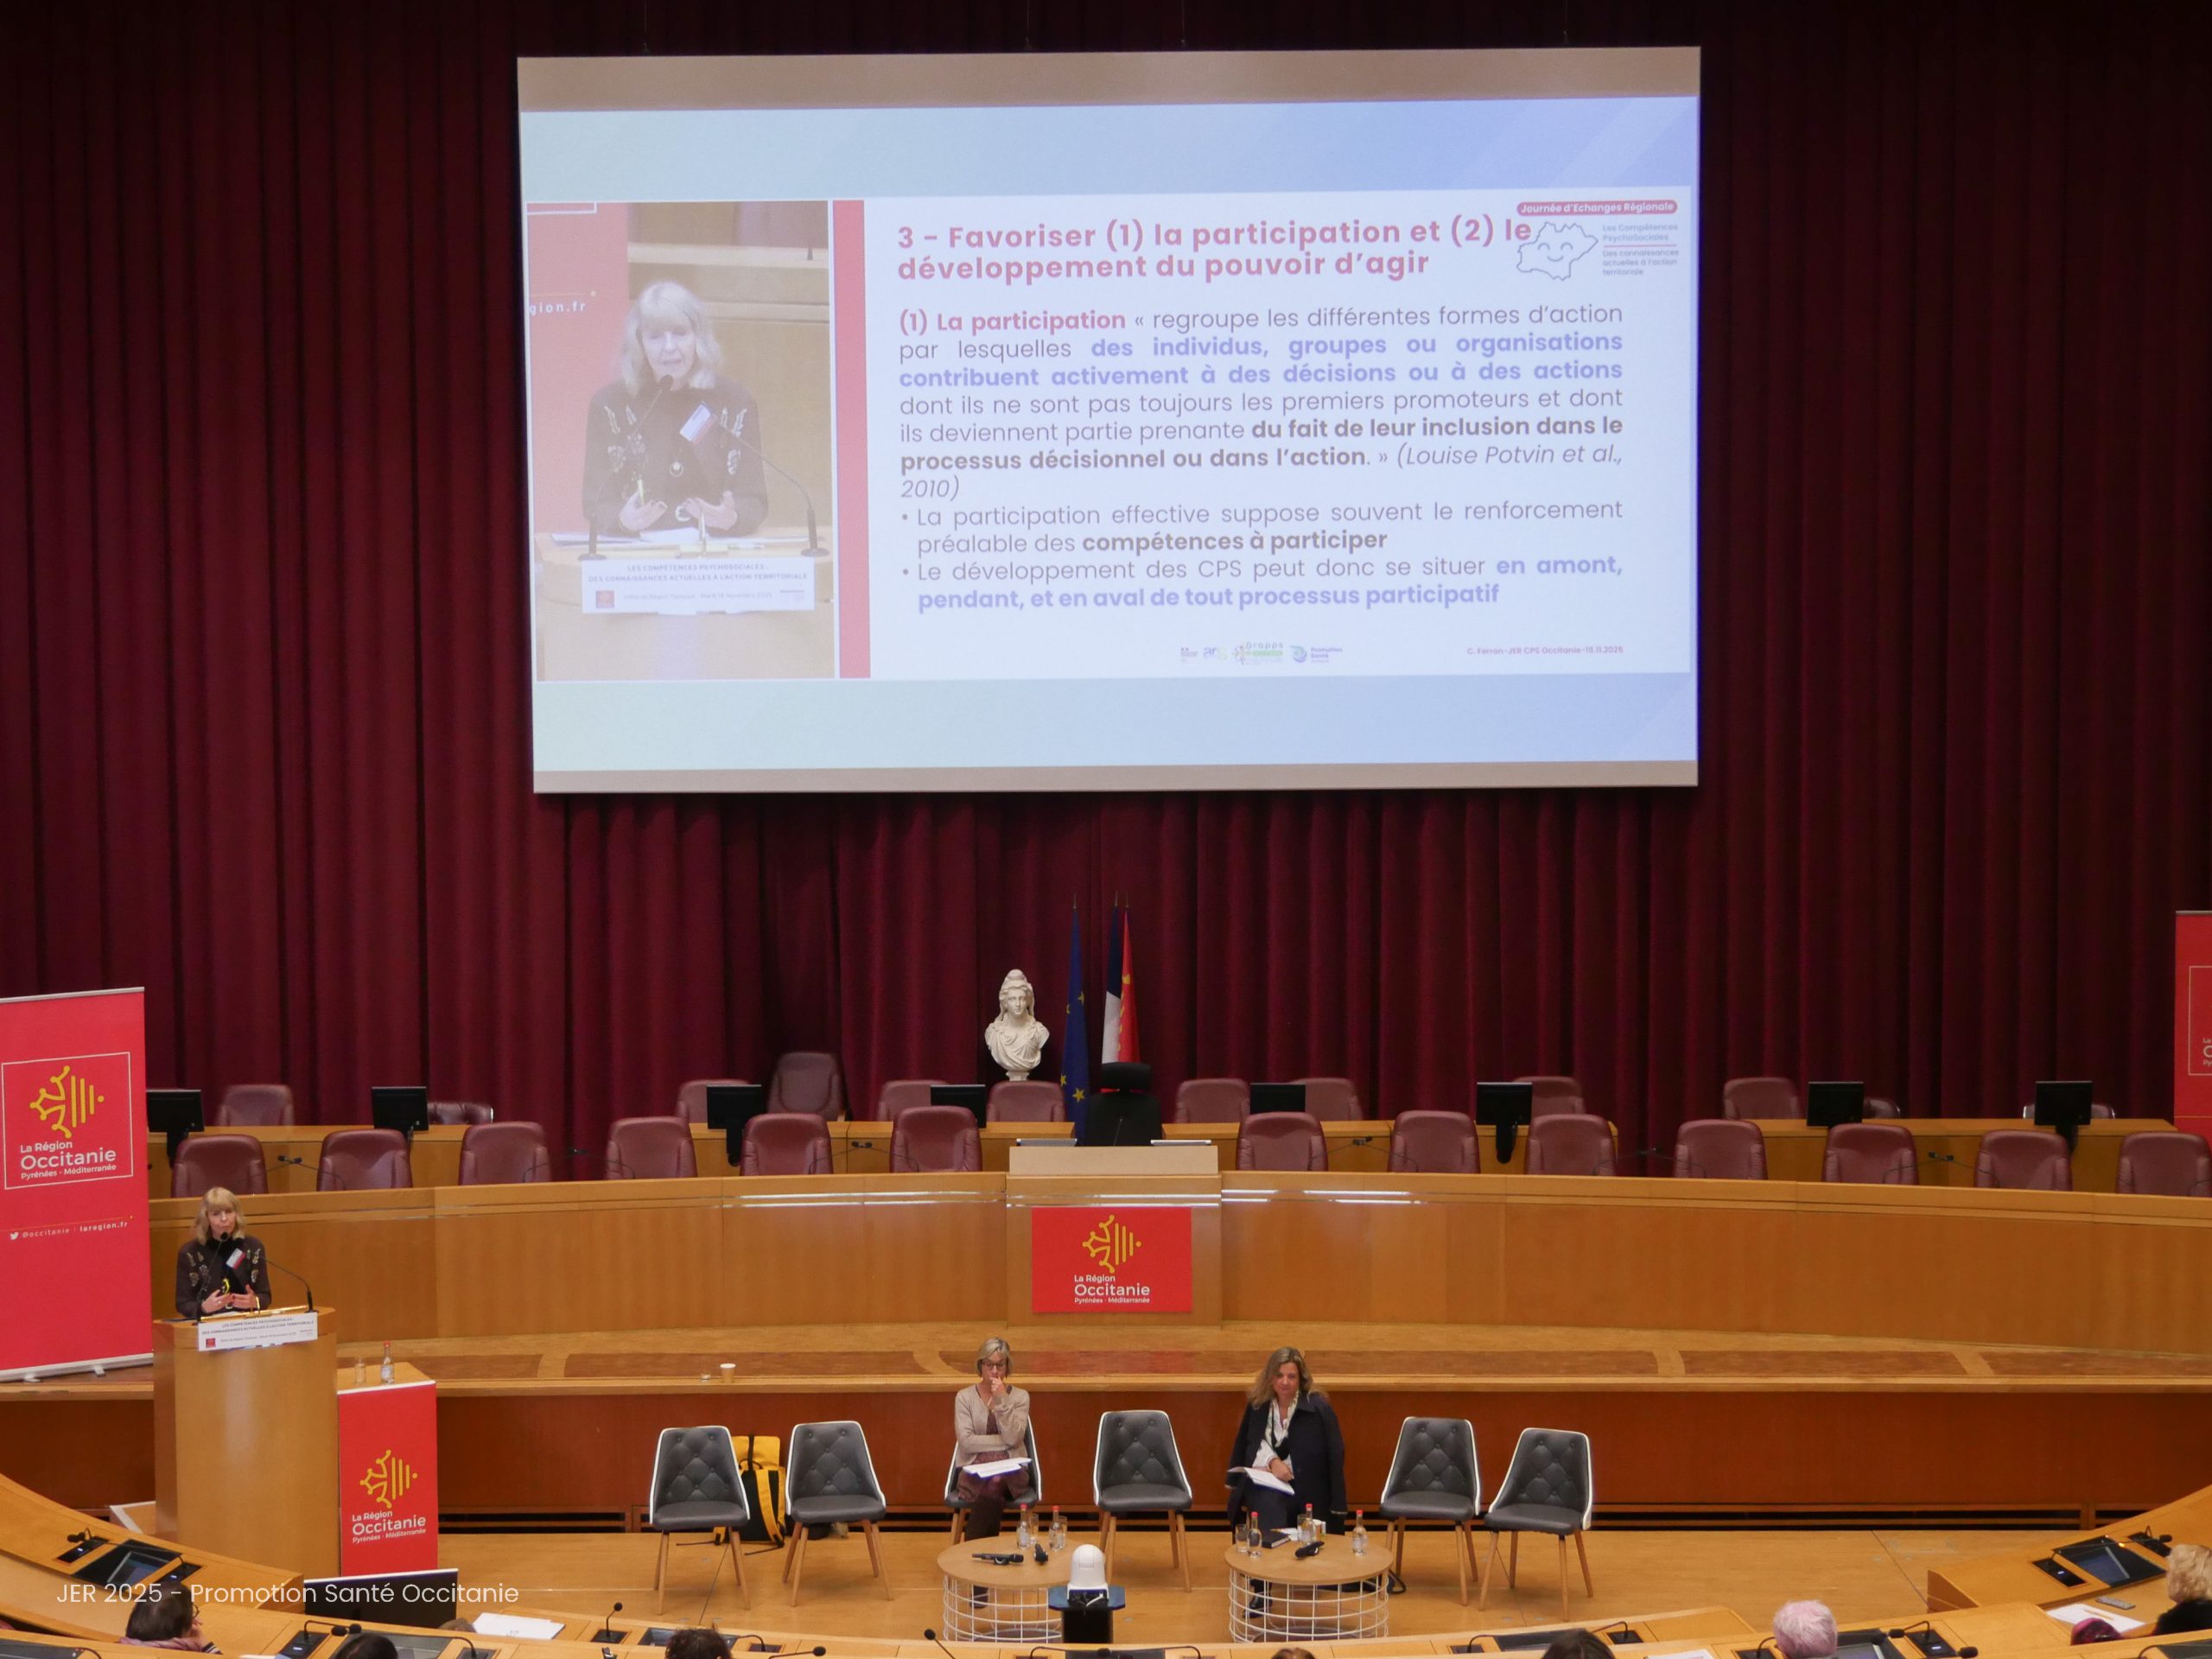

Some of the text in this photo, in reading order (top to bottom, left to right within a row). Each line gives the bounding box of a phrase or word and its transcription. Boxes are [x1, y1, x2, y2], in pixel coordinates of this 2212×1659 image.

[1521, 204, 1561, 213] Journée
[1624, 202, 1674, 213] Régionale
[899, 226, 912, 249] 3
[950, 223, 1096, 248] Favoriser
[1107, 219, 1143, 252] (1)
[1155, 224, 1181, 245] la
[1193, 219, 1400, 252] participation
[1410, 221, 1440, 242] et
[1452, 214, 1493, 247] (2)
[1505, 219, 1531, 241] le
[899, 256, 1147, 286] développement
[1156, 254, 1194, 276] du
[1205, 251, 1325, 283] pouvoir
[900, 308, 927, 336] (1)
[938, 314, 962, 331] La
[972, 309, 1125, 336] participation
[1154, 313, 1258, 334] regroupe
[1268, 308, 1298, 327] les
[1307, 307, 1430, 327] différentes
[1440, 306, 1519, 325] formes
[900, 331, 1623, 365] par lesquelles des individus, groupes ou organisations
[899, 359, 1622, 387] contribuent activement à des décisions ou à des actions
[900, 388, 1623, 419] dont ils ne sont pas toujours les premiers promoteurs et dont
[901, 416, 1623, 447] ils deviennent partie prenante du fait de leur inclusion dans le
[901, 442, 1622, 476] processus décisionnel ou dans l'action. (Louise Potvin et al.,
[900, 475, 959, 501] 2010)
[918, 500, 1623, 531] La participation effective suppose souvent le renforcement
[918, 529, 1388, 559] préalable des compétences à participer
[918, 556, 1622, 585] Le développement des CPS peut donc se situer en amont,
[919, 583, 1499, 614] pendant, et en aval de tout processus participatif
[20, 1141, 73, 1154] La Région
[20, 1147, 117, 1170] Occitanie
[21, 1163, 117, 1180] Pyrénées Méditerranée
[79, 1220, 128, 1233] laregion.fr
[1074, 1282, 1151, 1297] Occitanie
[1085, 1274, 1116, 1284] Région
[352, 1510, 393, 1522] La Région
[352, 1514, 427, 1535] Occitanie
